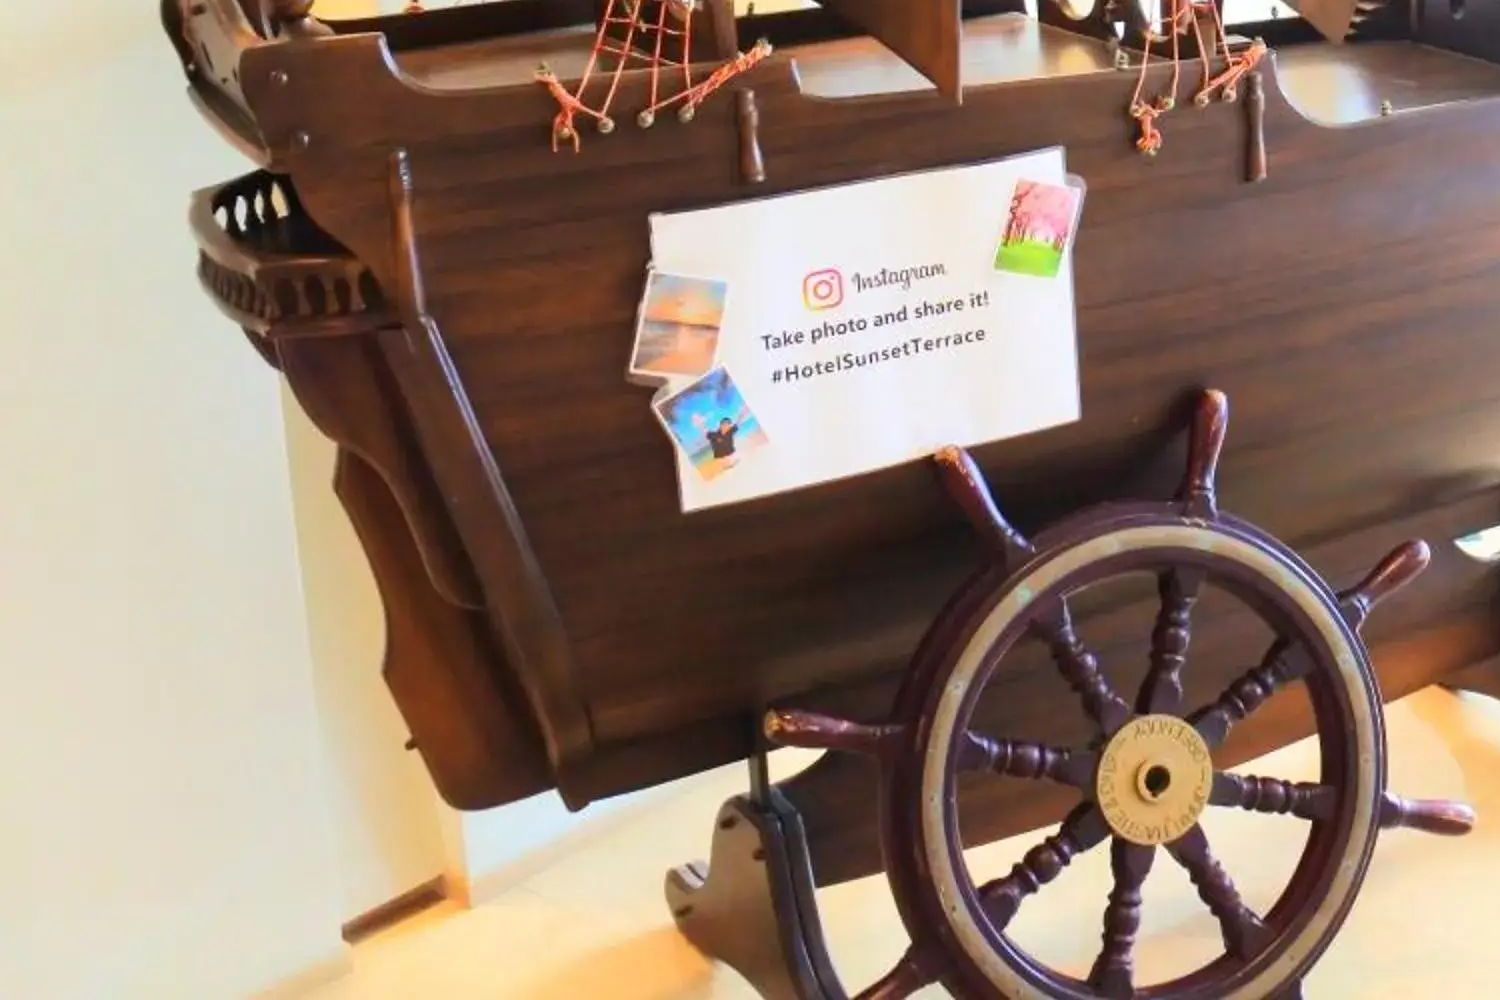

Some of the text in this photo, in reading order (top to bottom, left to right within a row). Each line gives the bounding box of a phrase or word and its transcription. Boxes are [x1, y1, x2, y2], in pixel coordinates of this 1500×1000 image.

[852, 263, 945, 292] Instagram
[760, 289, 989, 350] Take photo and share it!
[772, 329, 985, 383] #HotelSunsetTerrace
